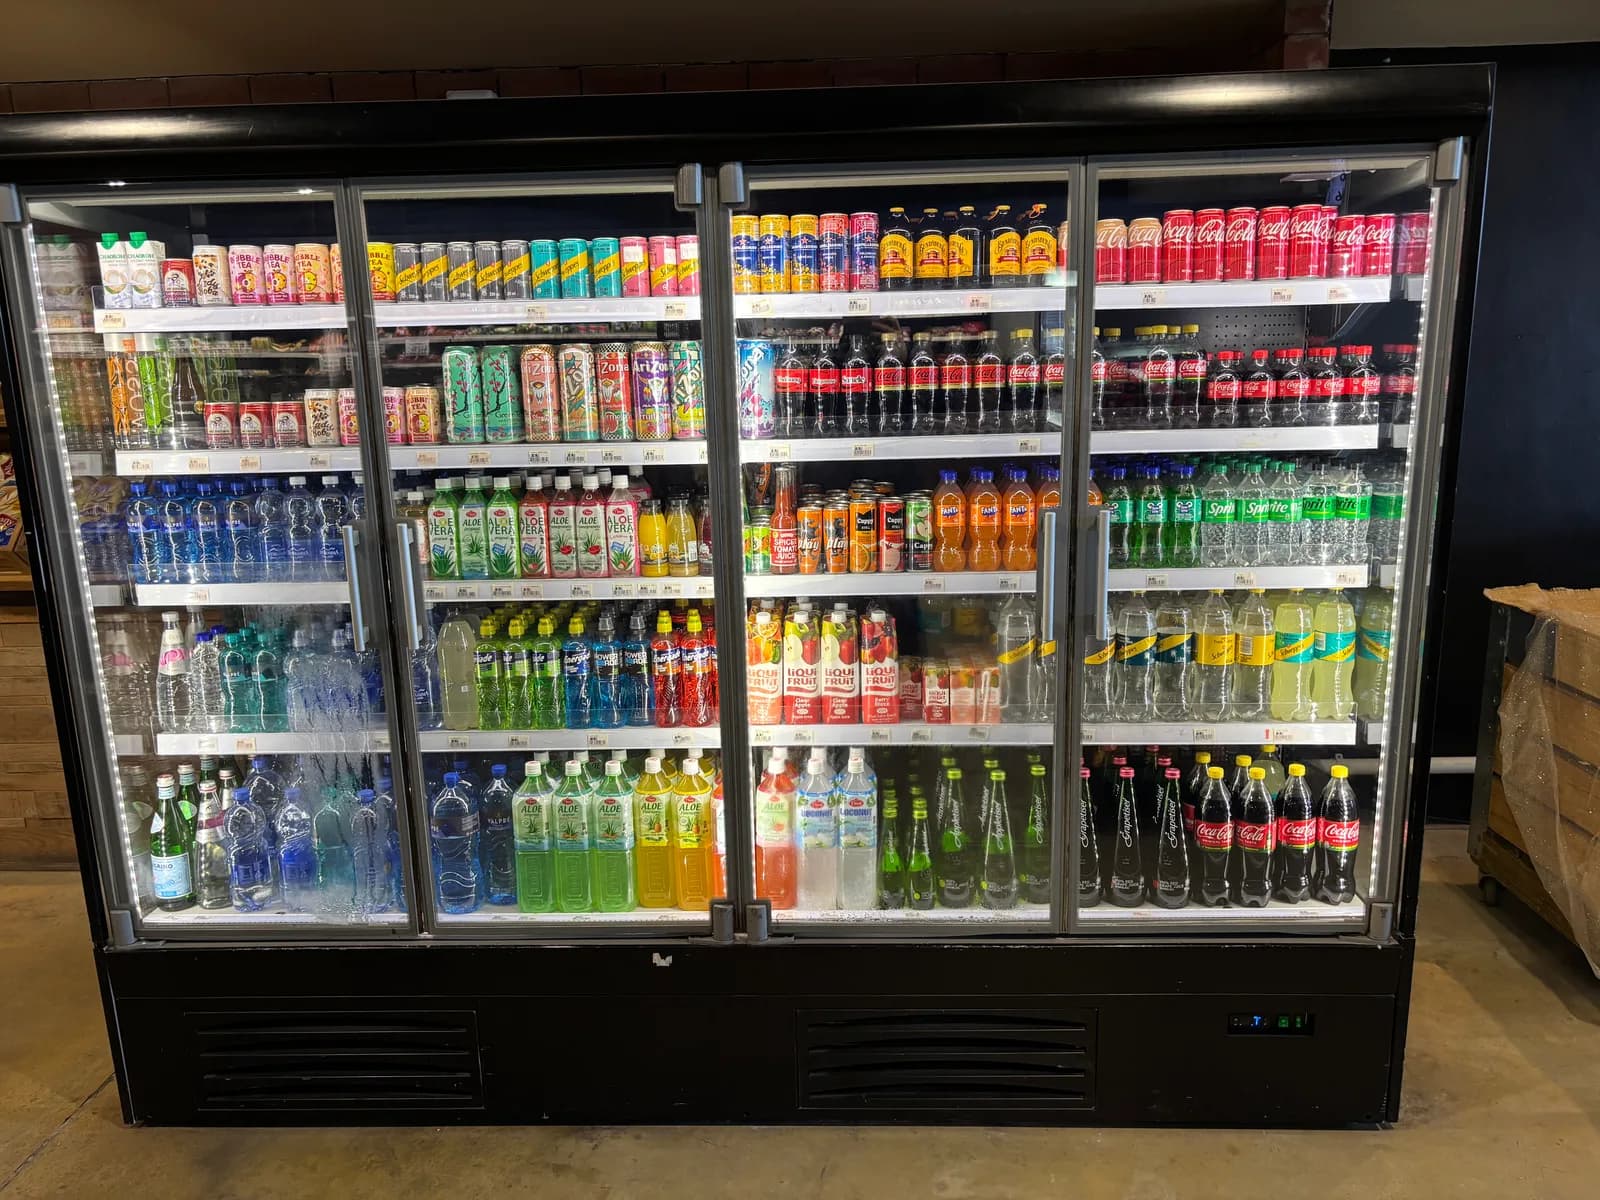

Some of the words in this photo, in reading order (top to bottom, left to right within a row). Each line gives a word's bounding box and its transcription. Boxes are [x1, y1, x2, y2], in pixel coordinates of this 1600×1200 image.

[238, 261, 252, 269] TEA
[463, 518, 483, 526] ALOE
[551, 517, 569, 525] ALOE
[579, 517, 597, 525] ALOE
[608, 515, 633, 525] ALOE
[608, 524, 634, 534] VERA
[521, 804, 543, 813] ALOE
[558, 804, 579, 813] ALOE
[600, 804, 621, 813] ALOE
[641, 802, 663, 812] ALOE
[679, 803, 703, 813] ALOE
[992, 800, 1004, 850] Appletiser
[1120, 799, 1132, 848] Grapetiser
[1164, 799, 1178, 849] Grapetiser
[1197, 823, 1234, 842] Coca-Cola
